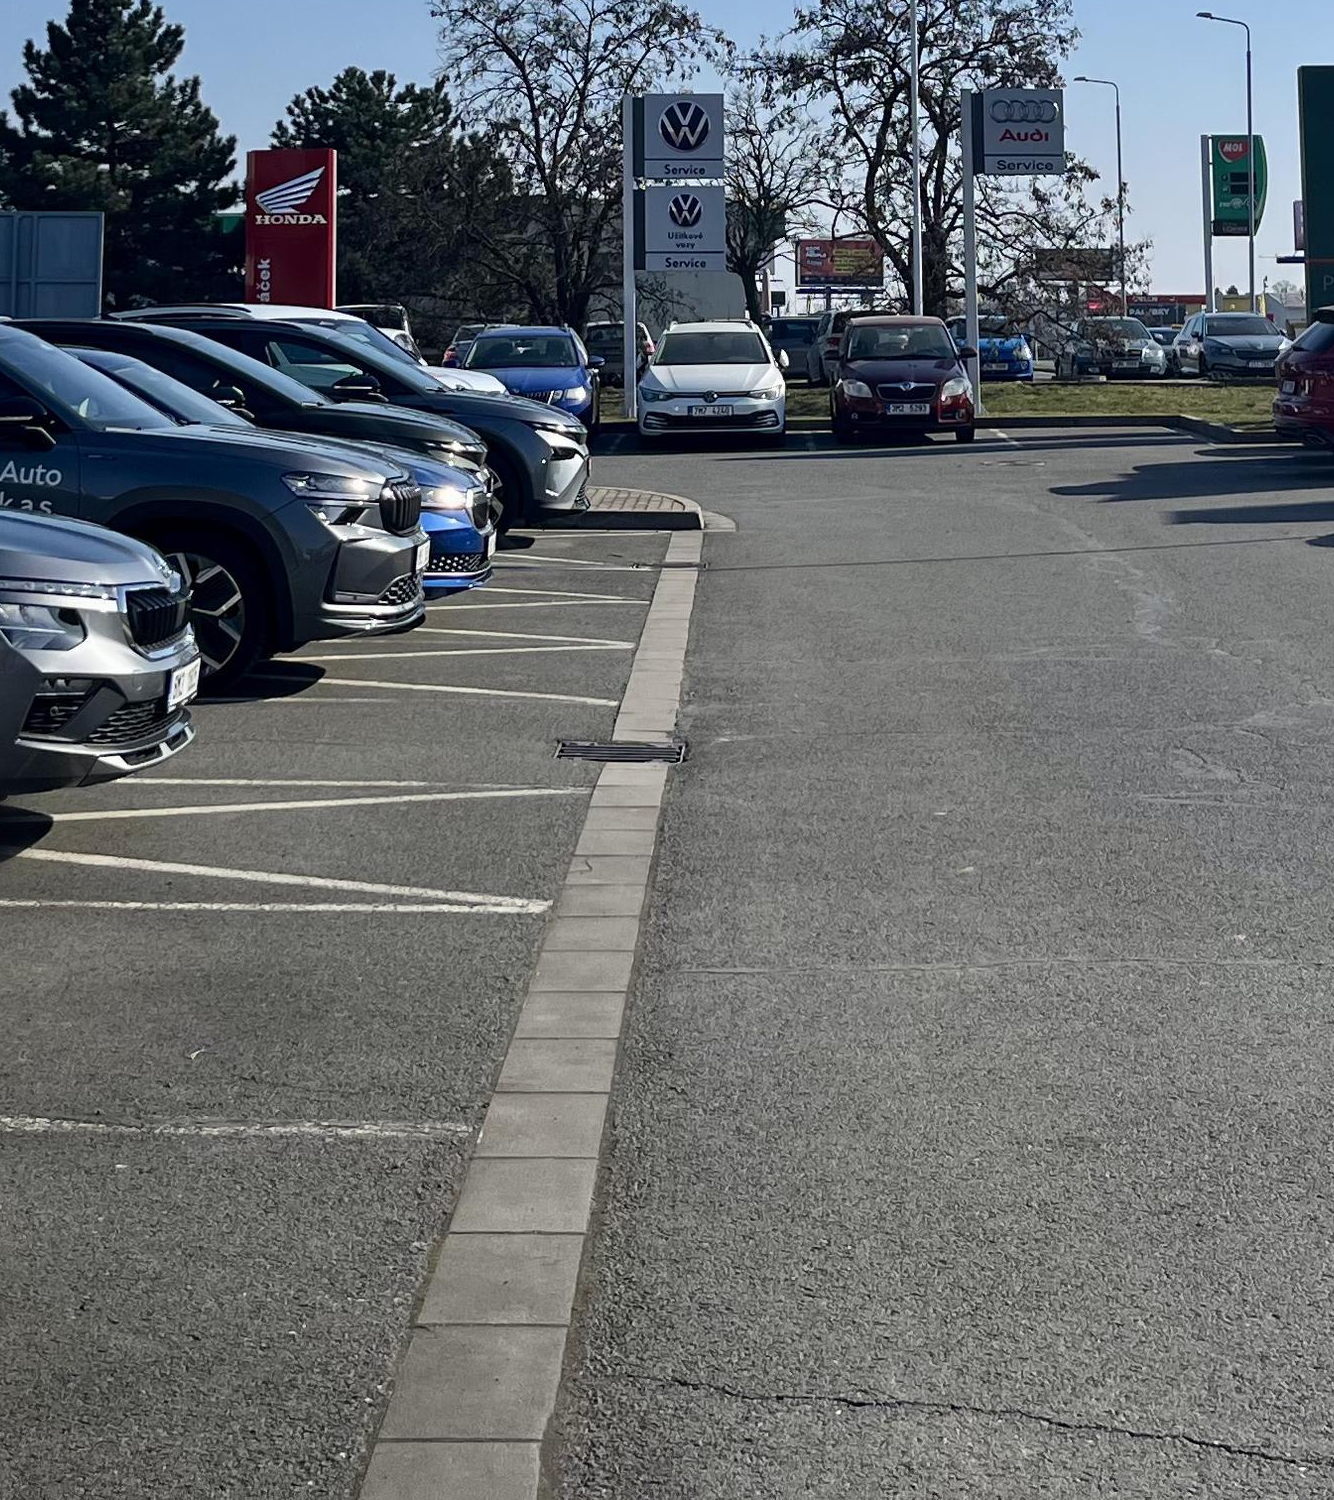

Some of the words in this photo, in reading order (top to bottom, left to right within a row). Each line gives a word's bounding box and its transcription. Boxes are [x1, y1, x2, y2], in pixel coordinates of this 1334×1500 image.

[998, 128, 1049, 142] Audi
[664, 164, 706, 176] Service
[996, 160, 1053, 171] Service
[255, 214, 327, 225] HONDA
[667, 231, 704, 240] Užitkové
[675, 242, 695, 250] vozy
[665, 257, 706, 268] Service
